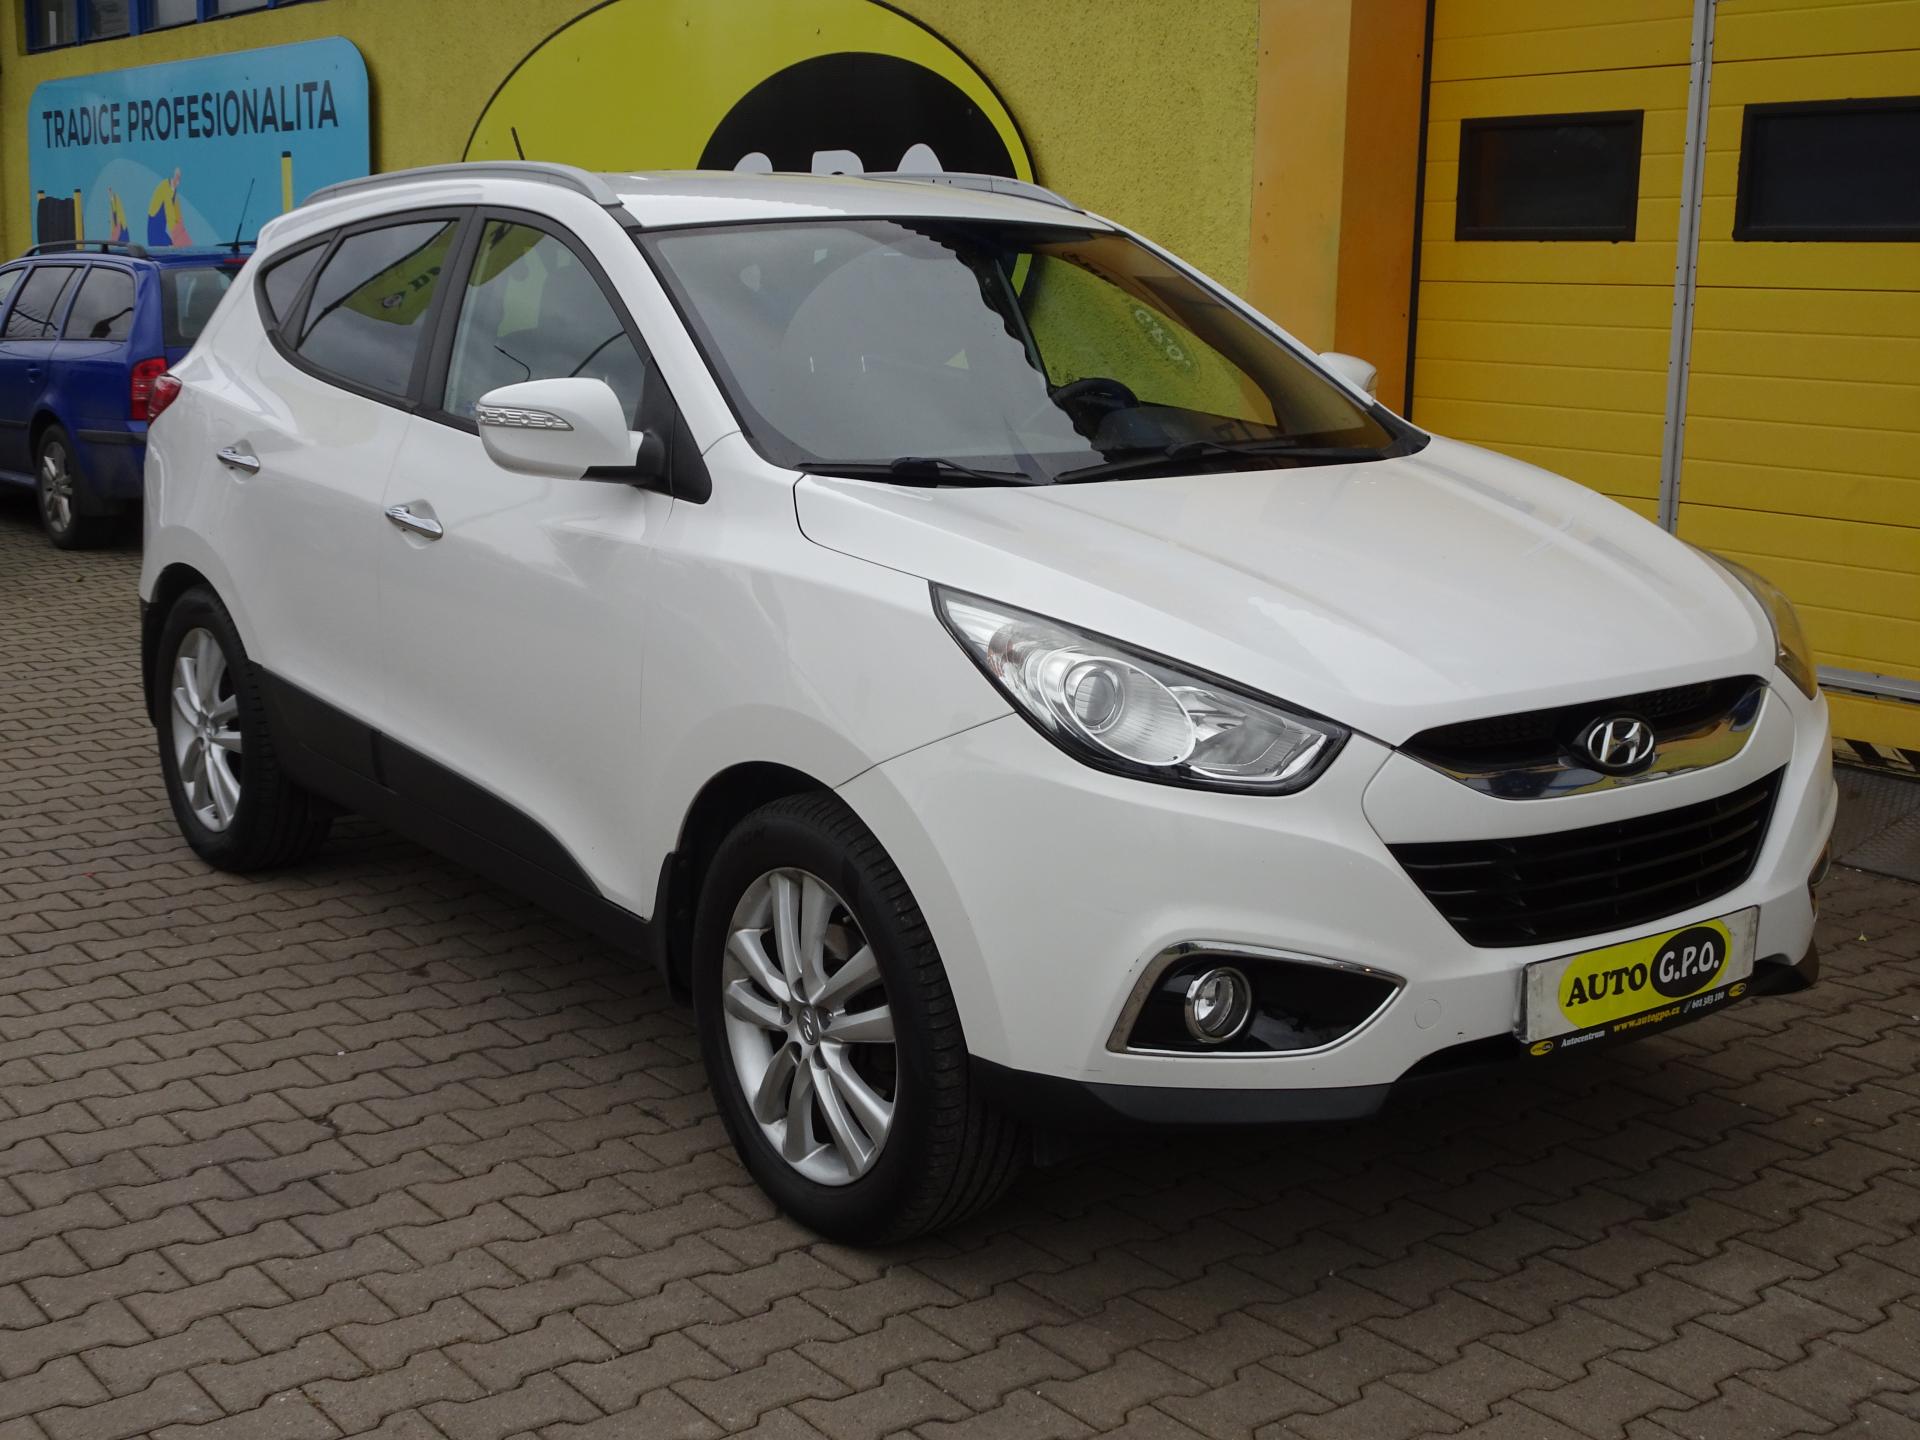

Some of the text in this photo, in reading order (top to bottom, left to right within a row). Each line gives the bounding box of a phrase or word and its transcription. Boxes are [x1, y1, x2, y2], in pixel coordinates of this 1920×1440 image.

[42, 80, 339, 148] TRADICE PROFESIONALITA
[1565, 941, 1719, 1007] AUTO G.P.O.
[1561, 1029, 1605, 1048] Autocentrum
[1613, 1006, 1680, 1032] www.autogpo.cz
